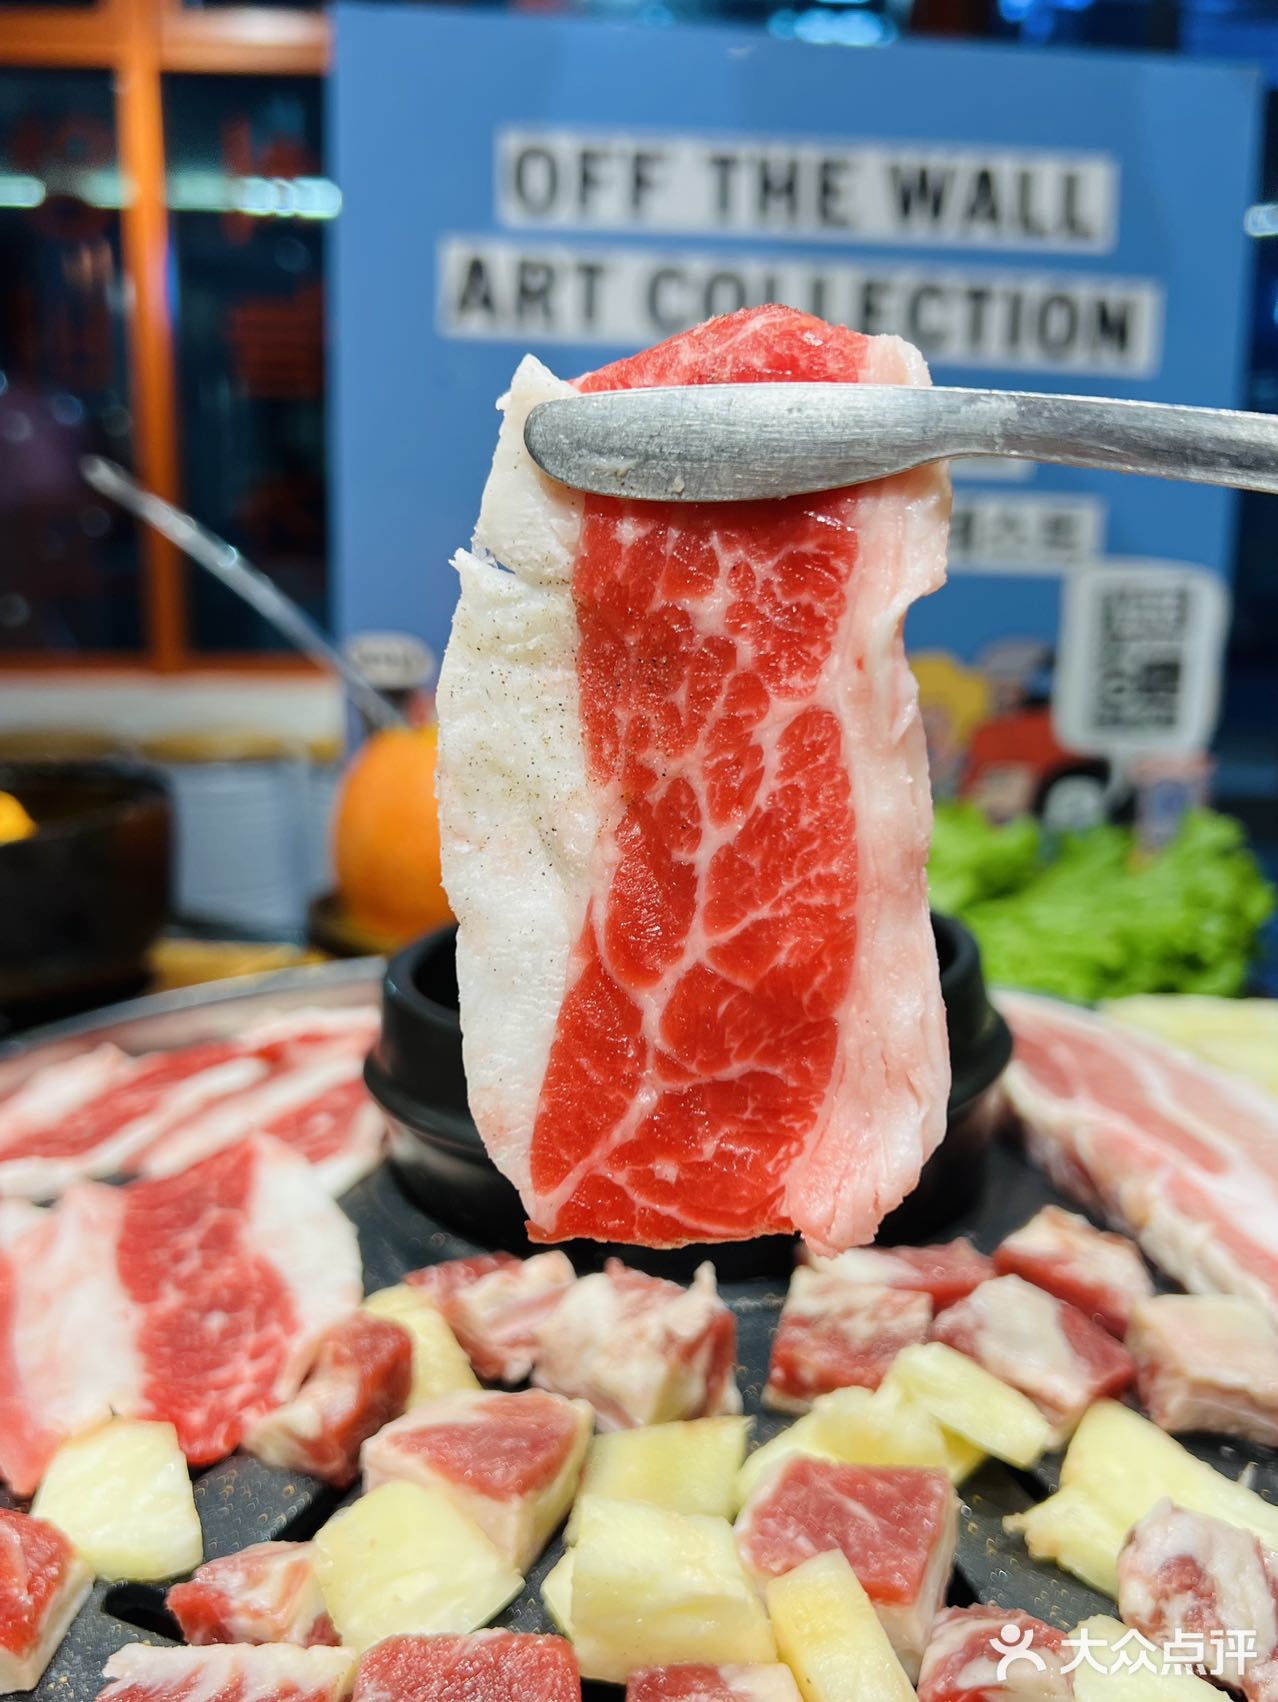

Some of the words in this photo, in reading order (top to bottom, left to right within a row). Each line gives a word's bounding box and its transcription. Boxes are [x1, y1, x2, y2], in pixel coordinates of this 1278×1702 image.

[512, 147, 674, 217] OFF
[708, 154, 854, 228] THE
[892, 165, 1100, 239] WALL
[457, 256, 605, 325] ART
